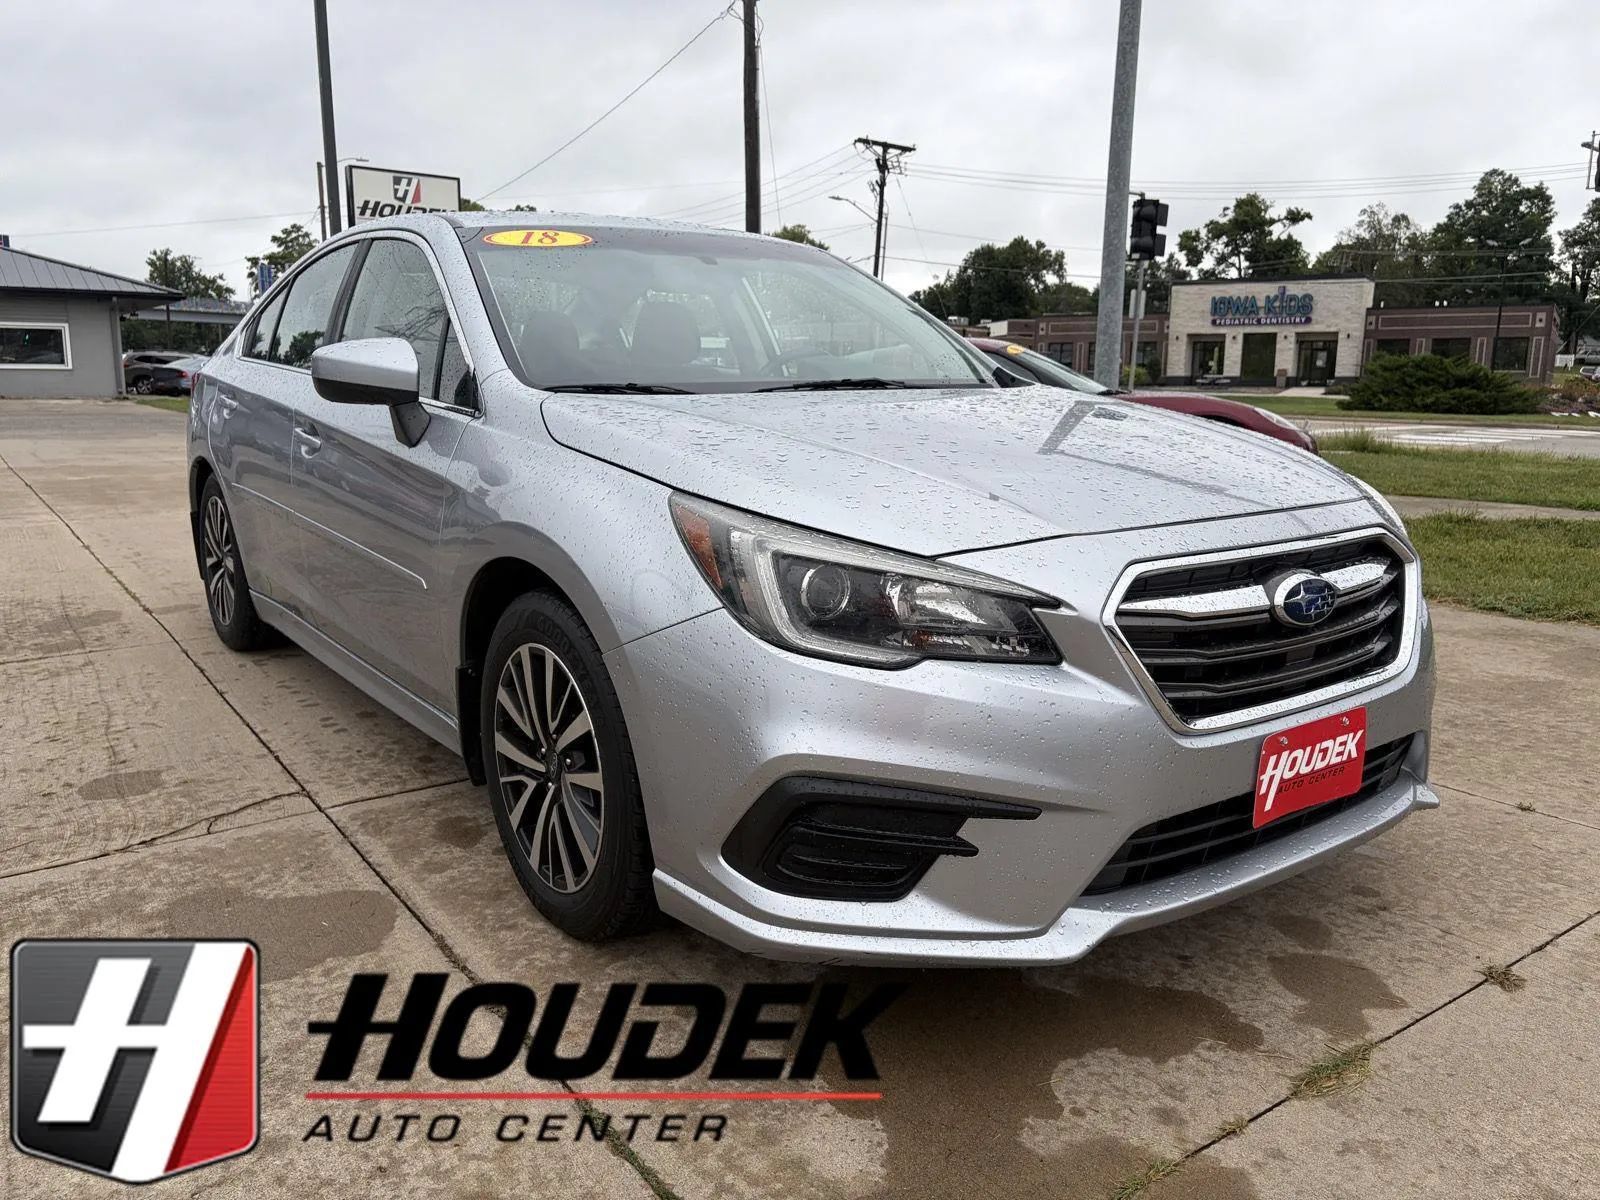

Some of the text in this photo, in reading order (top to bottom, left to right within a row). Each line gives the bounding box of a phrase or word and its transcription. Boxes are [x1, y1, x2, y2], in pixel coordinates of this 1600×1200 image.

[356, 200, 457, 218] HOU
[521, 231, 560, 245] 18
[1210, 286, 1314, 317] IOWA KIDS
[1215, 316, 1306, 326] PEDIATRIC DENTISTRY
[1259, 729, 1365, 812] HOUDEK
[1279, 766, 1345, 794] AUTO CENTER
